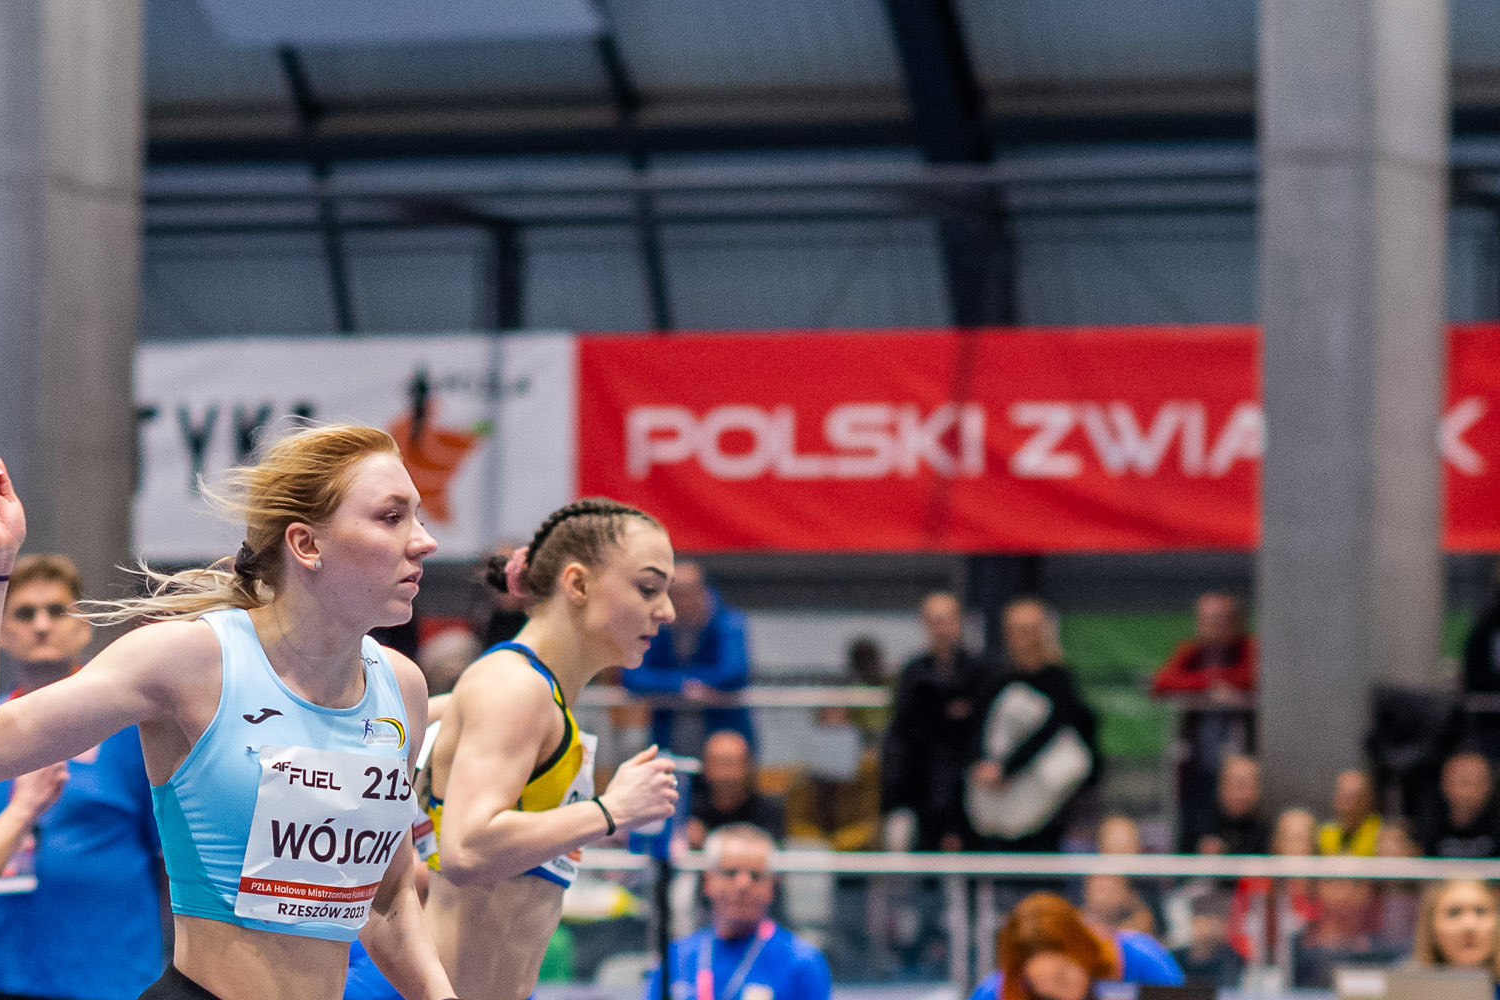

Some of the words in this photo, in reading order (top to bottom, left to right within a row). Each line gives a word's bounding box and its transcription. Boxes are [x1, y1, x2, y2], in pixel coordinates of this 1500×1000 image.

[626, 402, 985, 481] POLSKI
[288, 767, 342, 791] FUEL
[271, 817, 402, 865] WÓJCIK
[251, 882, 272, 892] PZLA
[274, 883, 306, 896] Halowe
[277, 902, 341, 919] RZESZÓW
[342, 906, 365, 919] 2023
